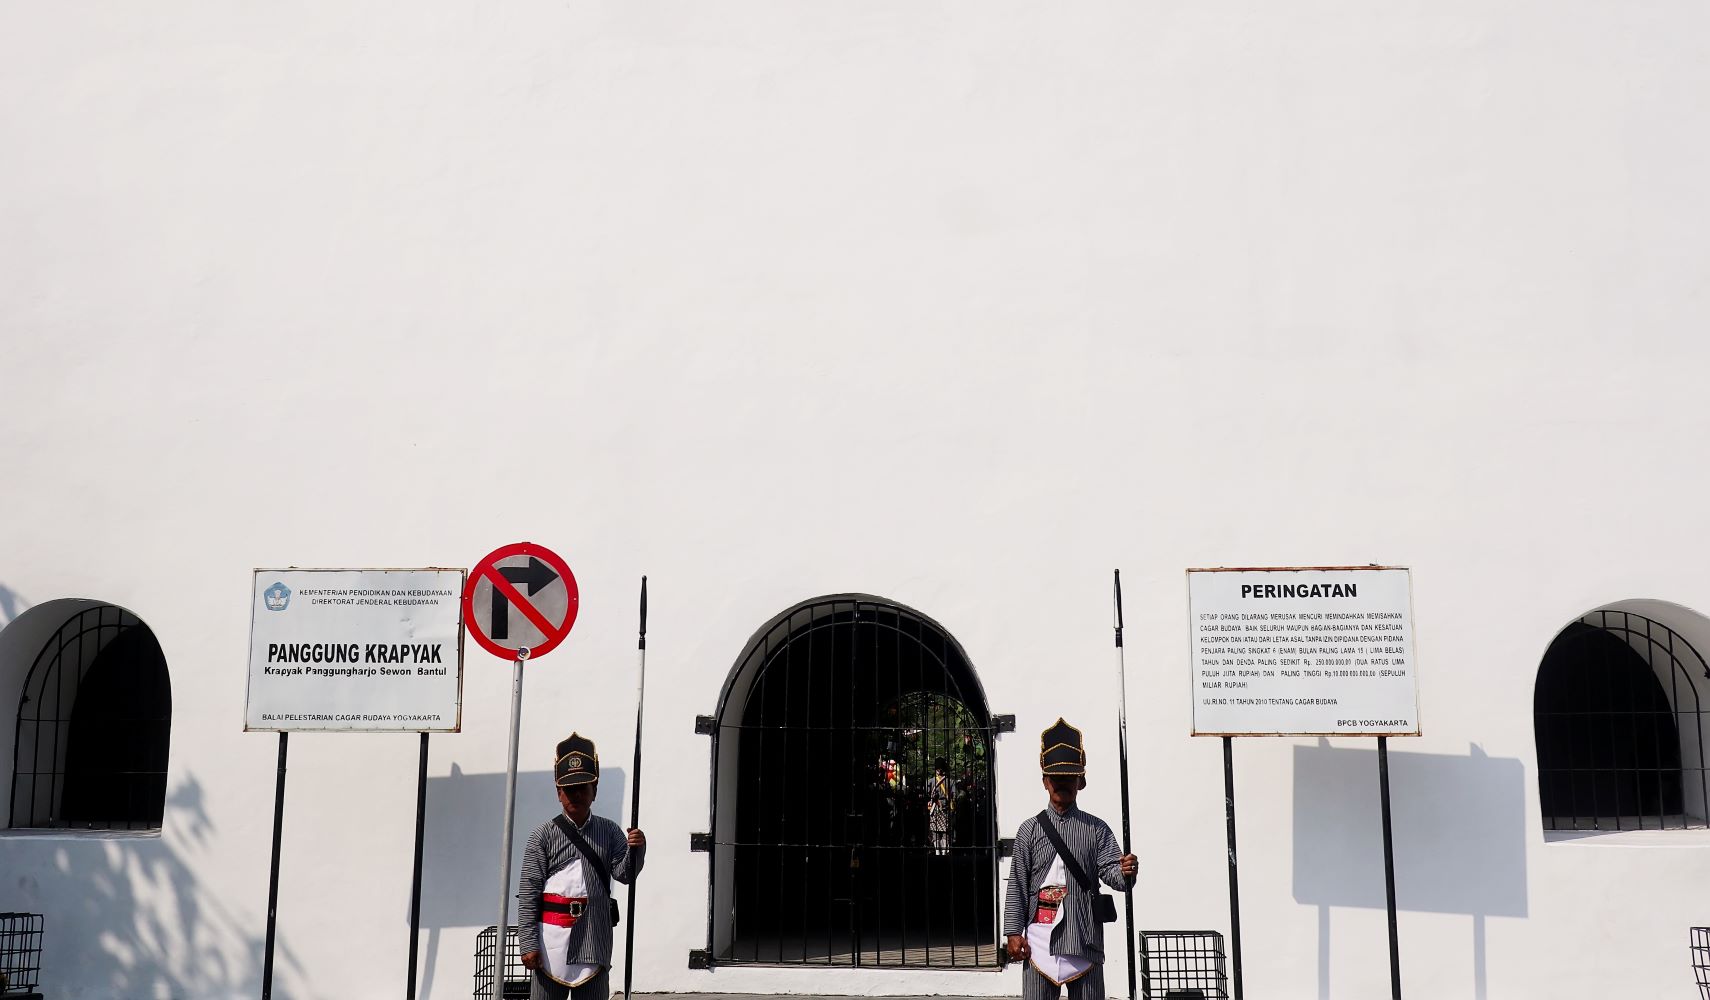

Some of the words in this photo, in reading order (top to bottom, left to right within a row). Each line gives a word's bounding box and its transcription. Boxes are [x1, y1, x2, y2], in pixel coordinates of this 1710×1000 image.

[1242, 584, 1357, 598] PERINGATAN
[268, 644, 360, 663] PANGGUNG
[365, 644, 442, 663] KRAPYAK
[264, 666, 302, 677] Krapyak
[306, 667, 376, 677] Panggungharjo
[380, 667, 412, 676] Sewon
[418, 667, 447, 676] Bantul
